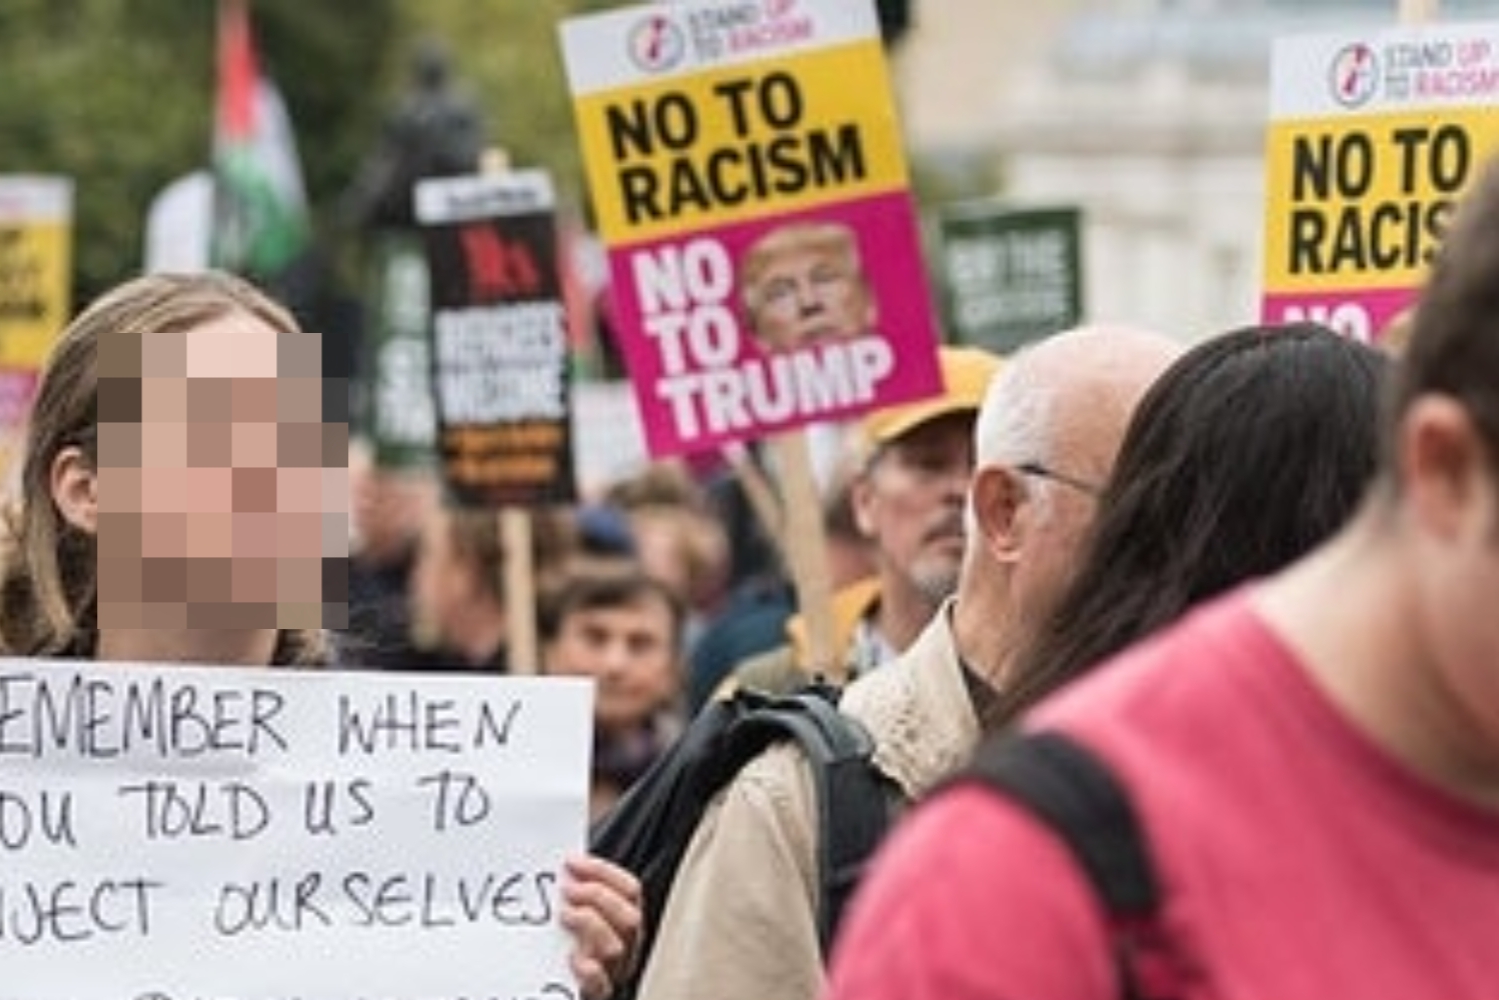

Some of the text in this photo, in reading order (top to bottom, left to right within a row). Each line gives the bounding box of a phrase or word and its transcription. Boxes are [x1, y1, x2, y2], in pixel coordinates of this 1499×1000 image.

[1385, 38, 1492, 69] STAND UP
[606, 71, 804, 163] NO TO
[618, 122, 867, 225] RACISM
[1292, 123, 1471, 200] NO TO
[1288, 200, 1454, 274] RACIS
[631, 238, 734, 315] NO
[643, 303, 739, 378] TO
[656, 335, 895, 442] TRUMP
[338, 689, 523, 755] WHEN
[117, 780, 270, 841] TOLD
[305, 779, 375, 836] US
[416, 770, 491, 832] TO
[214, 871, 557, 937] OURSELVES
